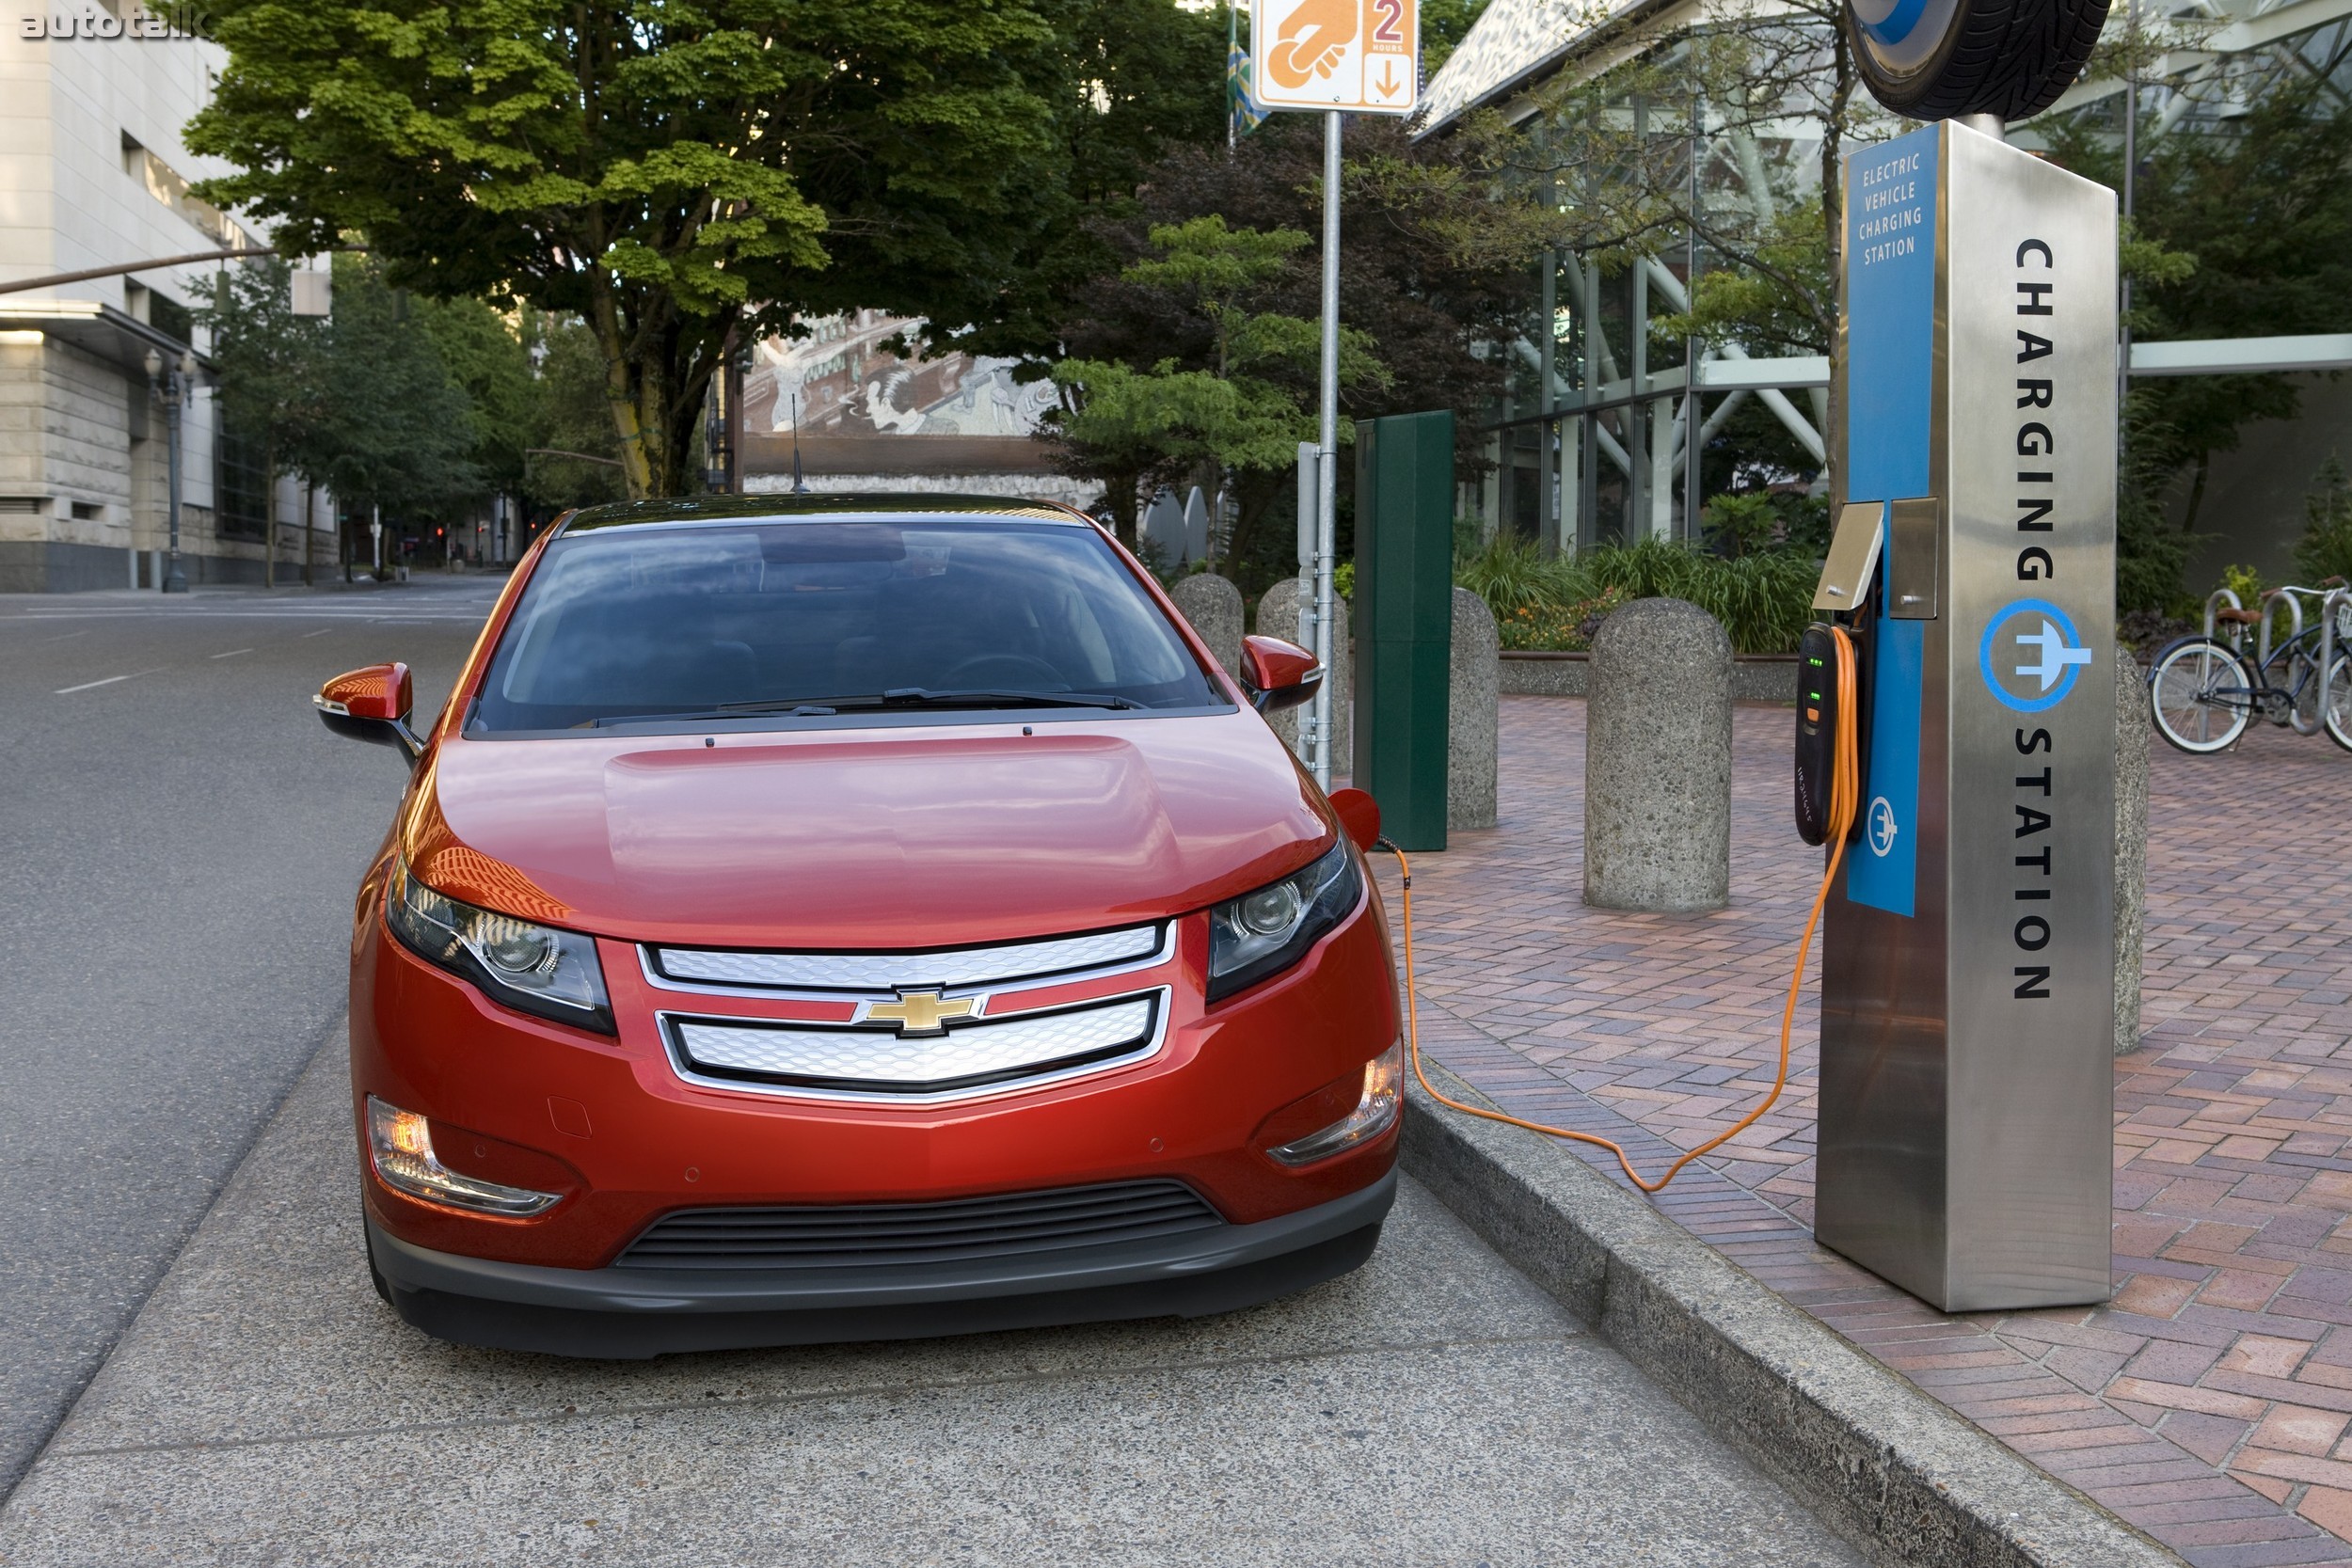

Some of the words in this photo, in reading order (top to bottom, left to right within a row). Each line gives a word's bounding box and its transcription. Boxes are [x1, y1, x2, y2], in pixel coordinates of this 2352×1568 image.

[1375, 0, 1402, 41] 2
[1373, 44, 1403, 53] HOURS
[1863, 153, 1920, 187] ELECTRIC
[1865, 182, 1915, 212] VEHICLE
[1859, 207, 1922, 241] CHARGING
[1865, 236, 1915, 266] STATION
[2016, 239, 2054, 581] CHARGING
[2013, 727, 2053, 1000] STATION
